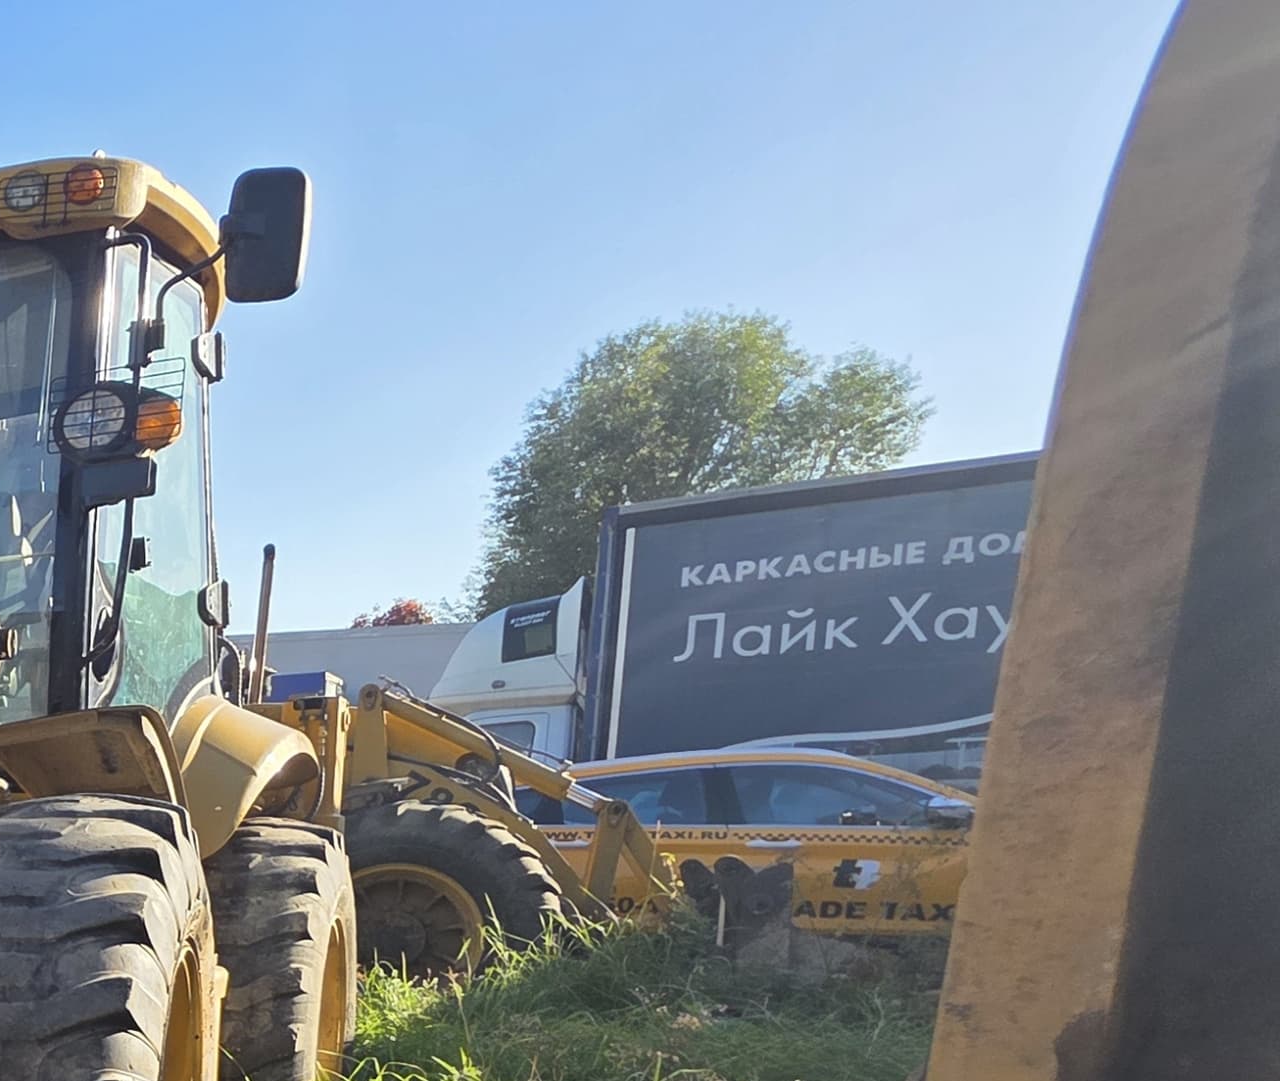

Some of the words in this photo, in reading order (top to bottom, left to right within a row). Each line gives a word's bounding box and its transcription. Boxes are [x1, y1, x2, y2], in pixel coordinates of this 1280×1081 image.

[681, 541, 927, 587] КАРКАСНЫЕ
[673, 607, 858, 662] Лайк
[881, 592, 1010, 653] Хау
[793, 901, 867, 919] ADE
[879, 901, 955, 921] TAX
